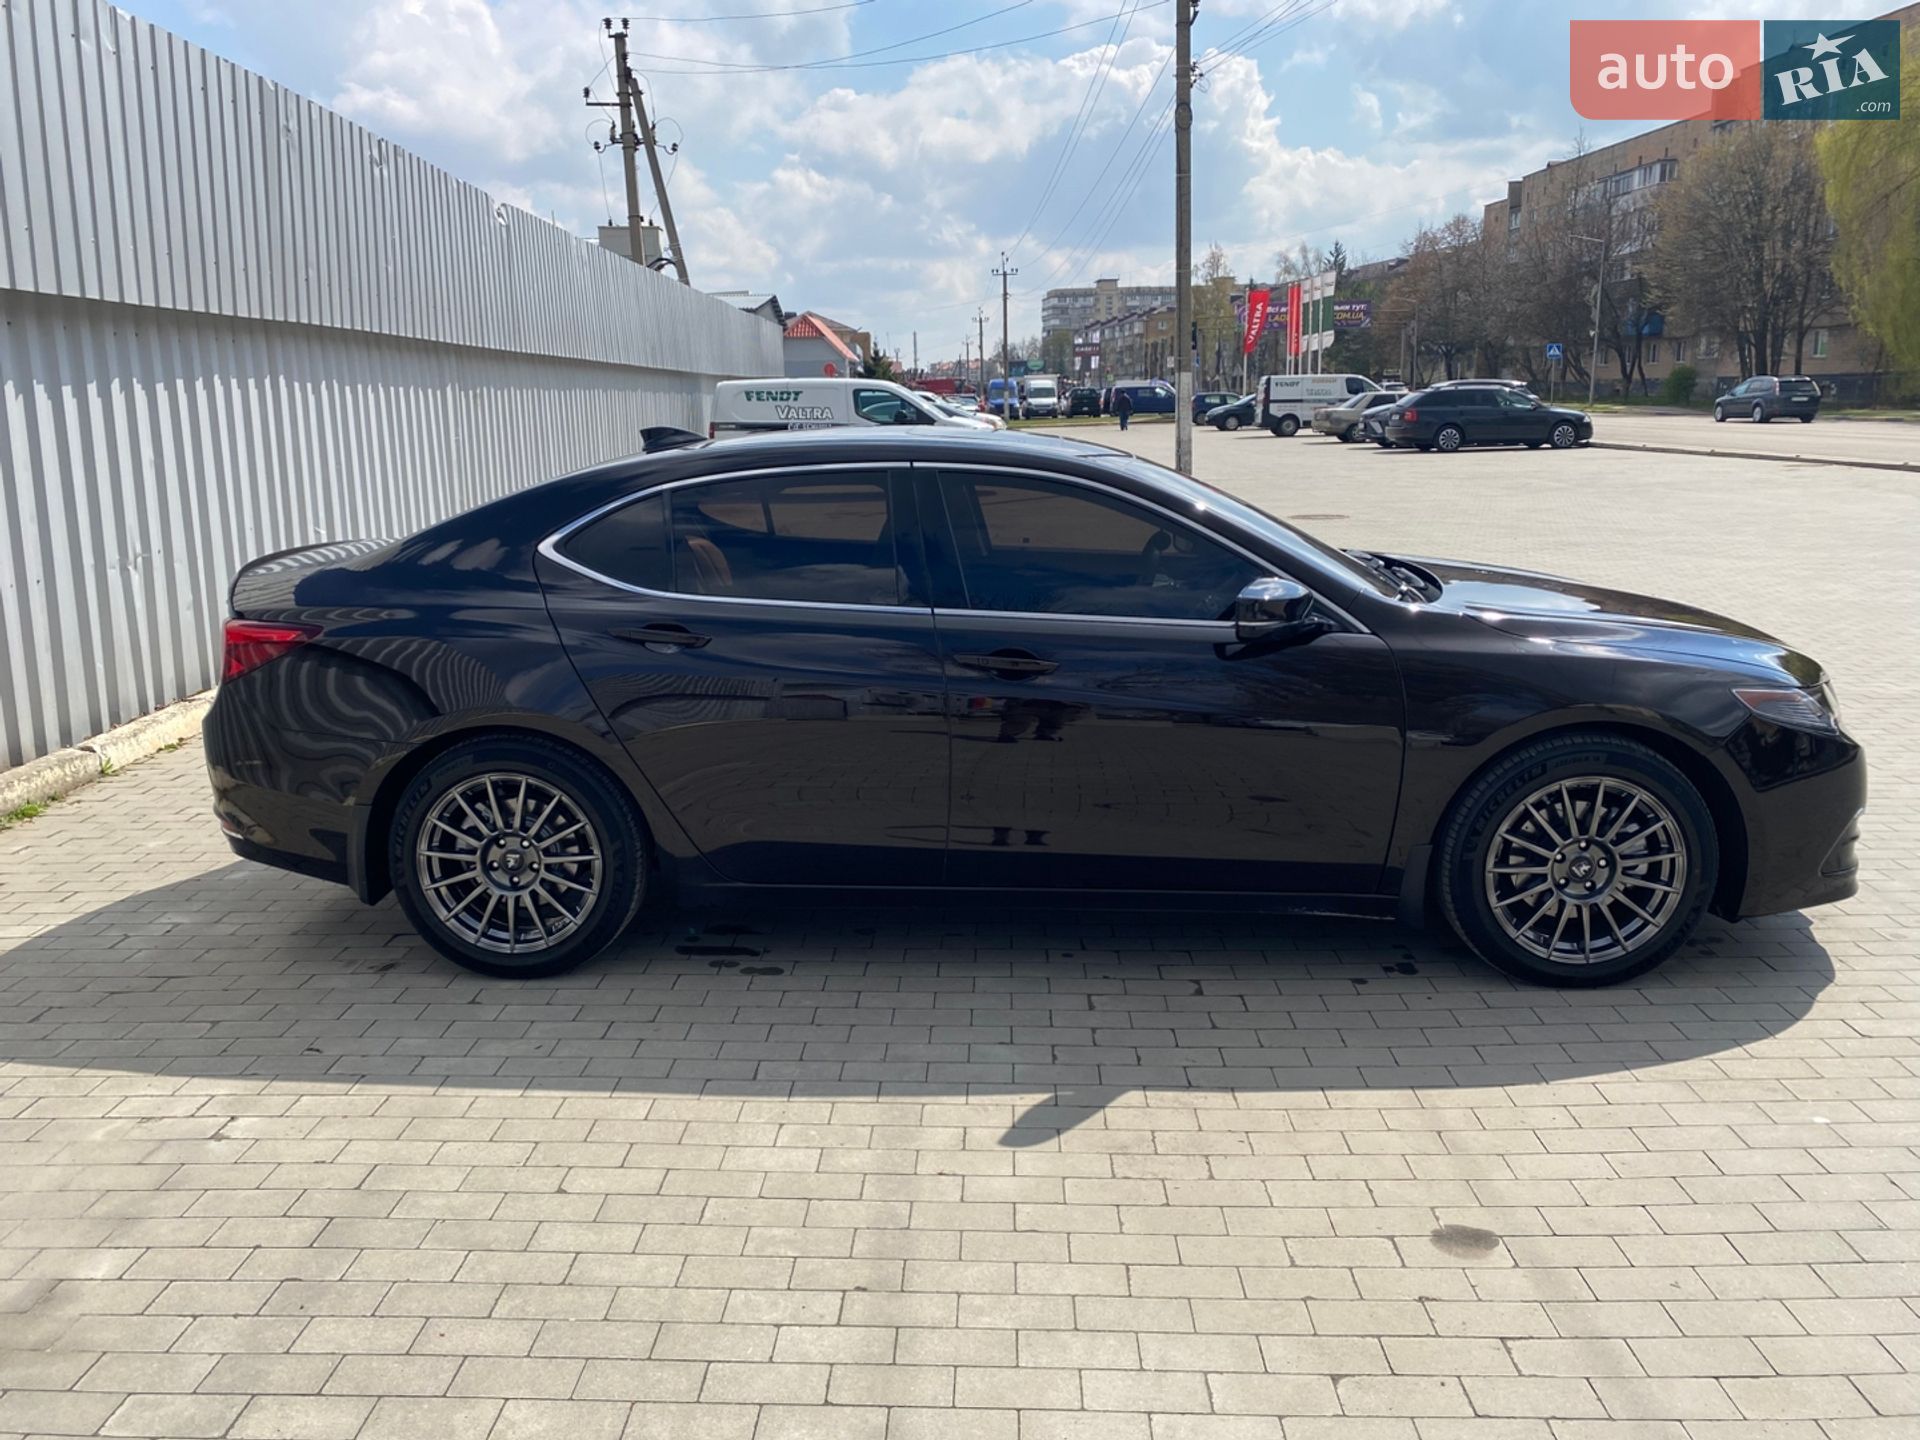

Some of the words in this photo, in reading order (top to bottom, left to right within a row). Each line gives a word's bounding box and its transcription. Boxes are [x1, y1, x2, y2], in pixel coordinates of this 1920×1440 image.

[1247, 302, 1264, 344] VALTRA
[744, 390, 803, 402] FENDT
[775, 405, 834, 420] VALTRA
